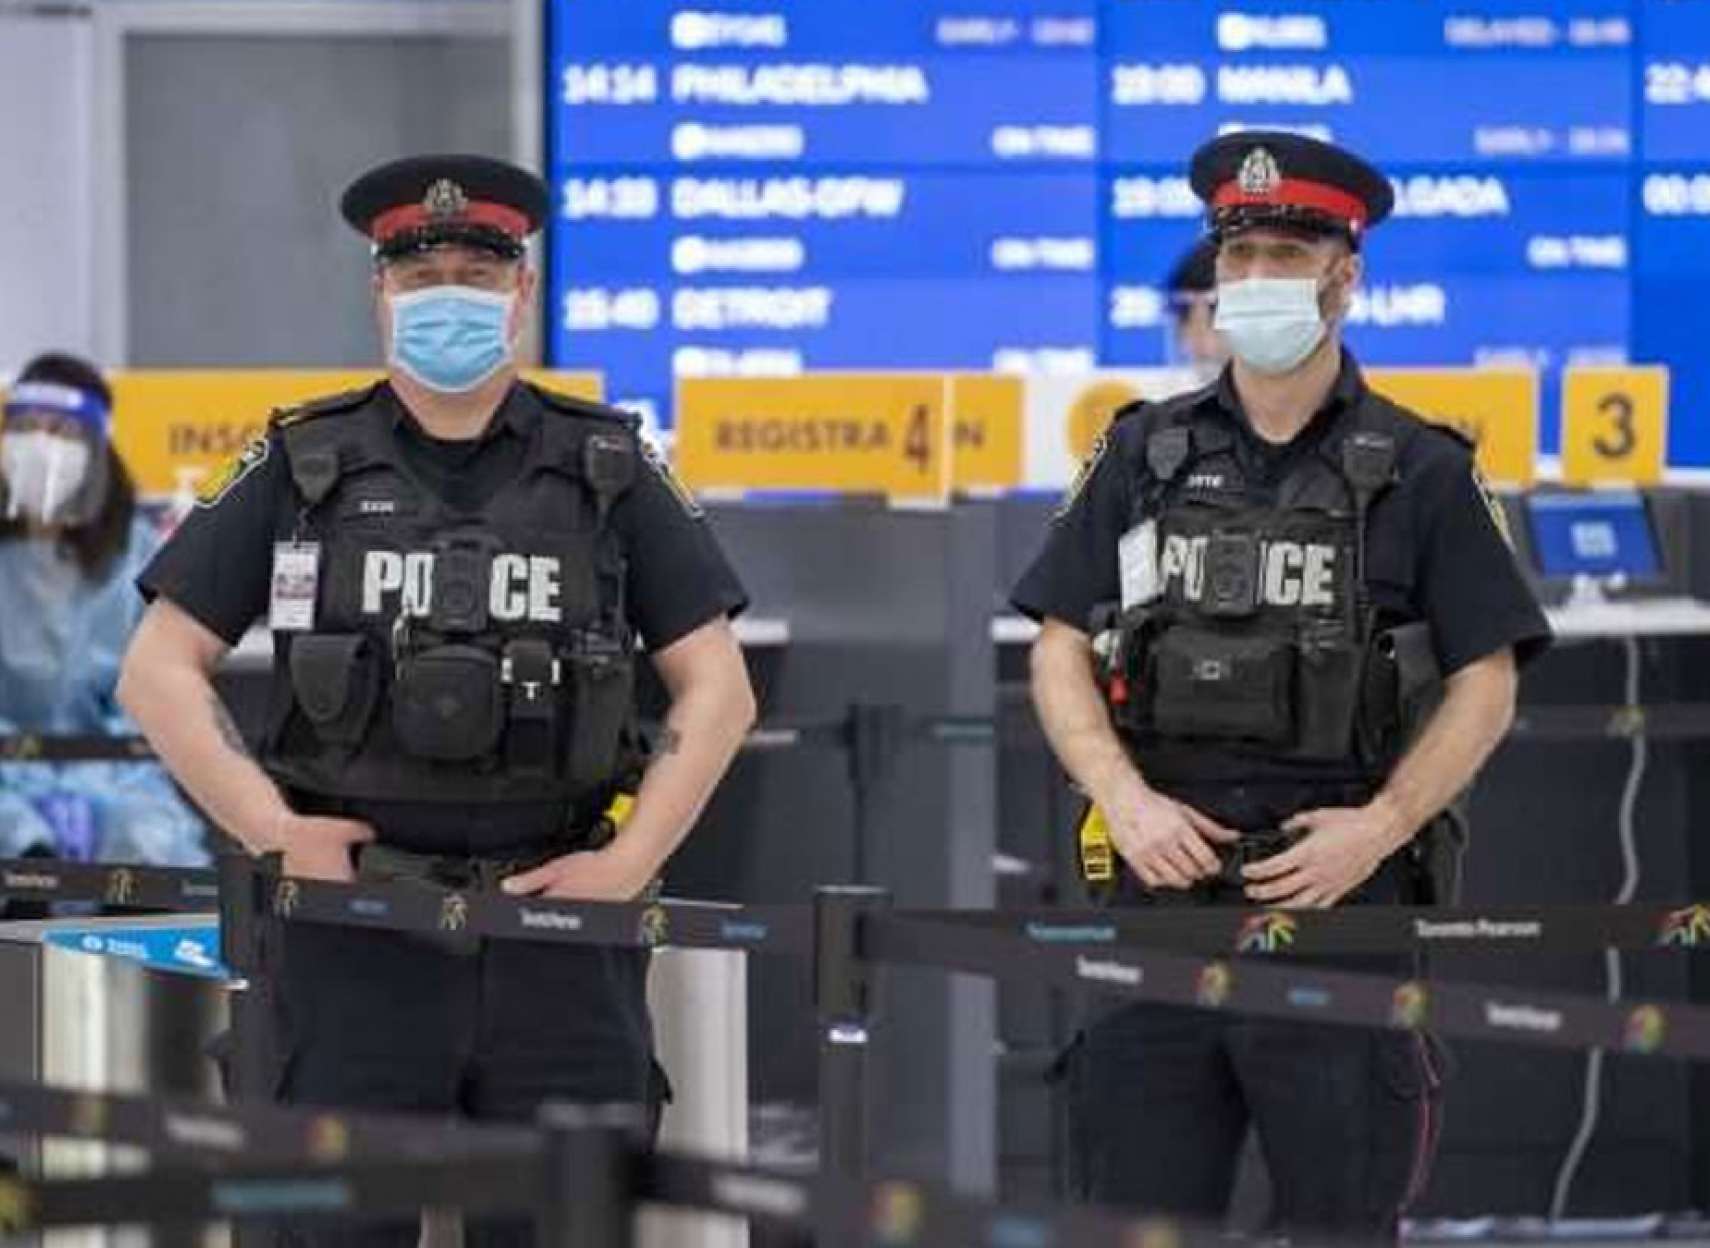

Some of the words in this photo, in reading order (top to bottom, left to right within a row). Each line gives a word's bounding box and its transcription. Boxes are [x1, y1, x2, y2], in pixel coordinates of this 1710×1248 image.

[673, 67, 926, 101] PHILADELPHIA
[903, 403, 929, 474] 4
[1594, 393, 1635, 459] 3
[362, 550, 561, 623] POCE
